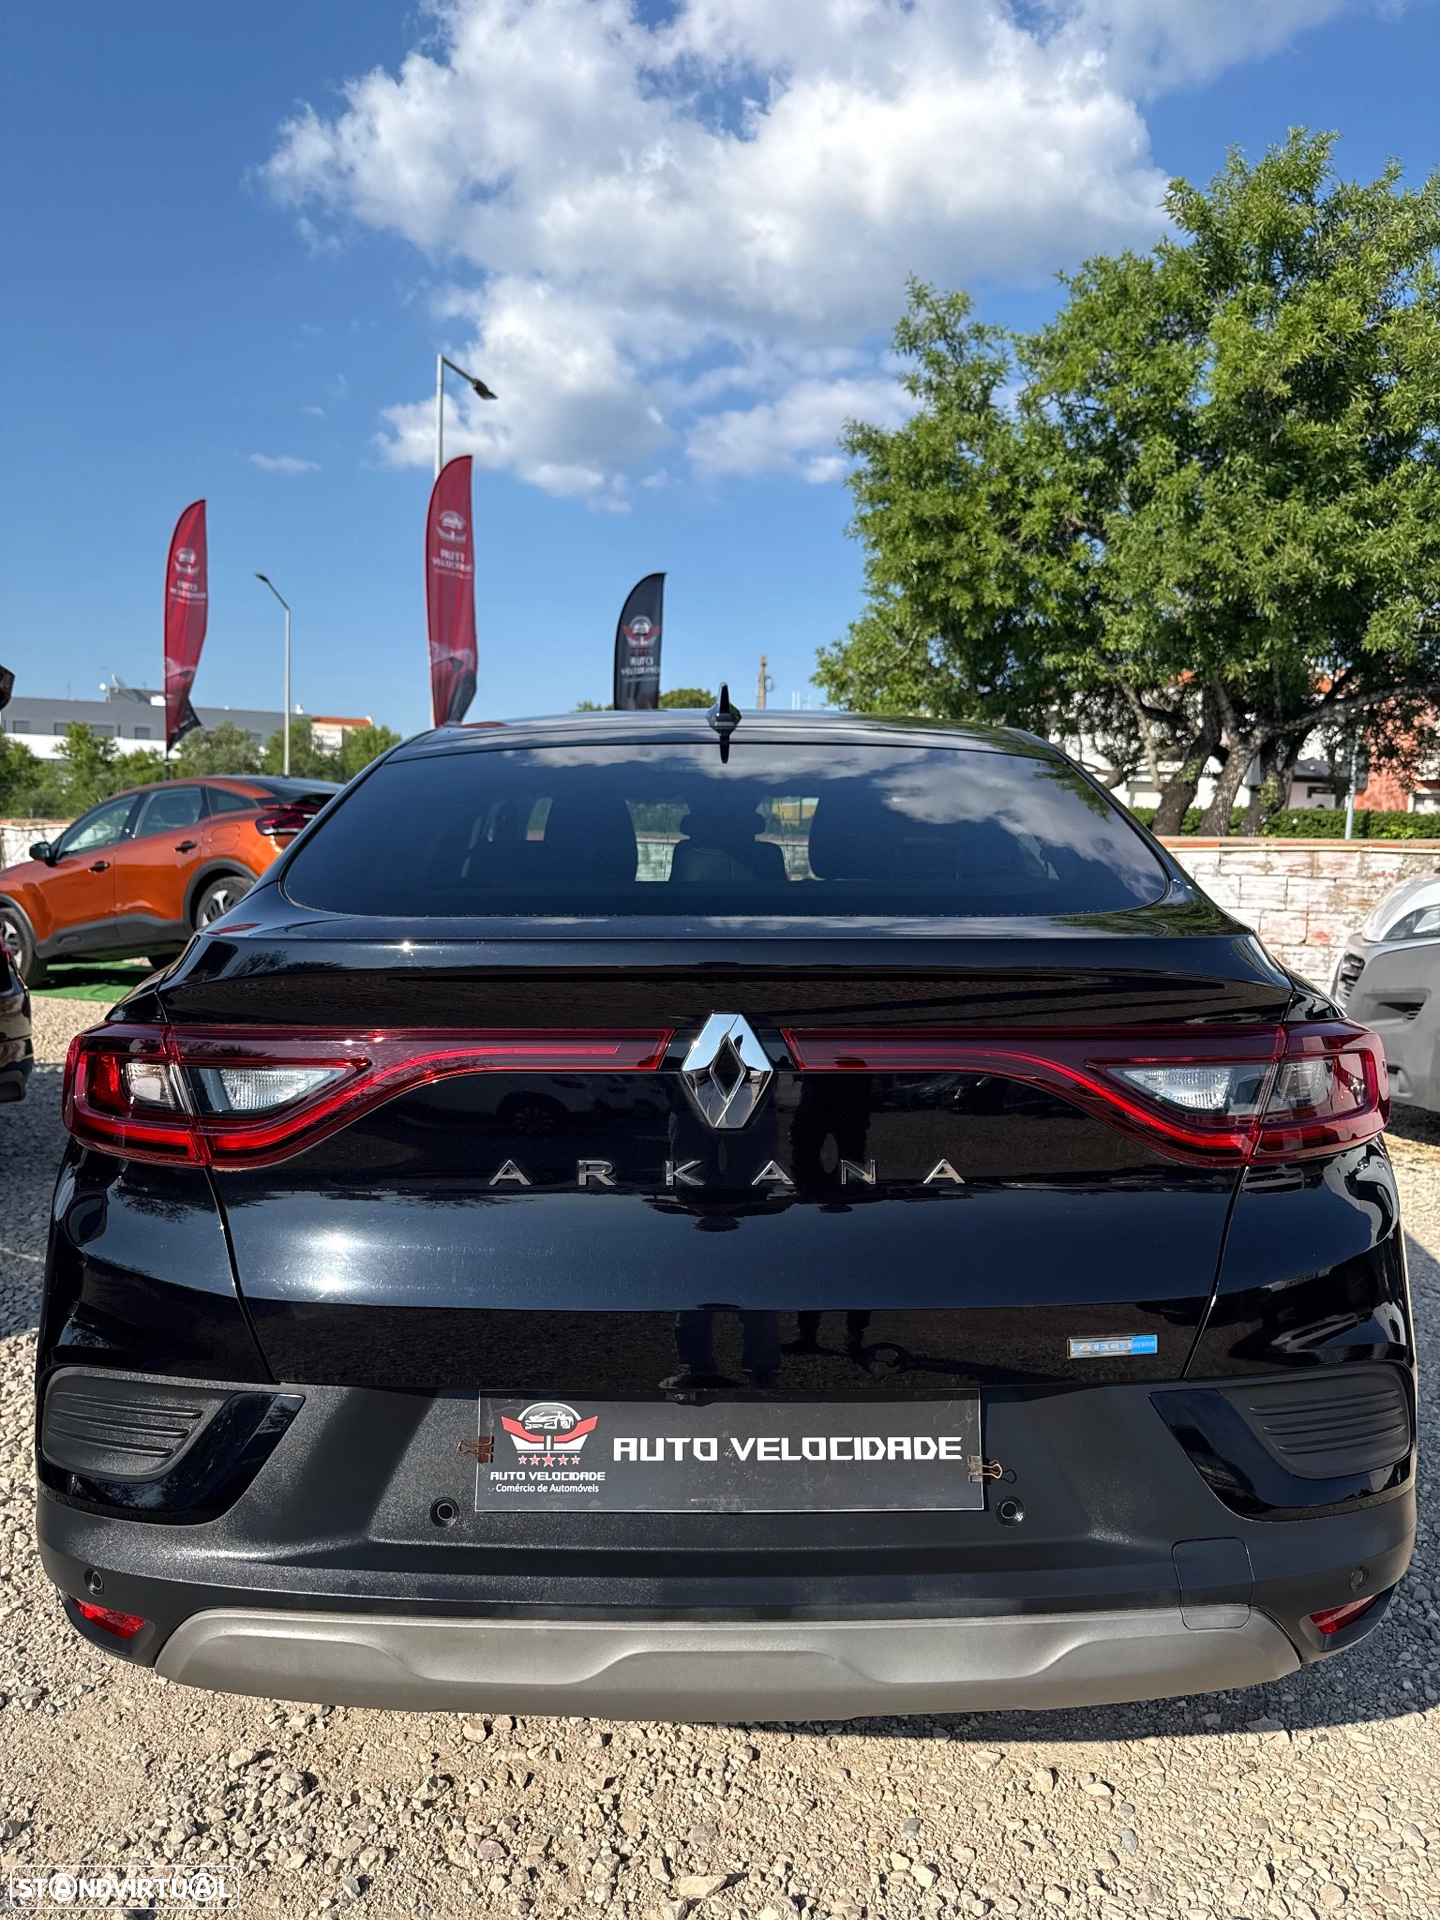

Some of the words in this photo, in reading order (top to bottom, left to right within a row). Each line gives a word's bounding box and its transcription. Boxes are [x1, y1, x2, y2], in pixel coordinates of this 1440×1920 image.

[489, 1158, 967, 1186] ARKANA
[613, 1437, 718, 1461] AUTO
[729, 1437, 963, 1461] VELOCIDADE
[490, 1471, 526, 1481] AUTO
[528, 1471, 606, 1481] VELOCIDADE
[495, 1483, 536, 1493] Comércio
[537, 1483, 548, 1493] de
[549, 1483, 600, 1493] Automóveis
